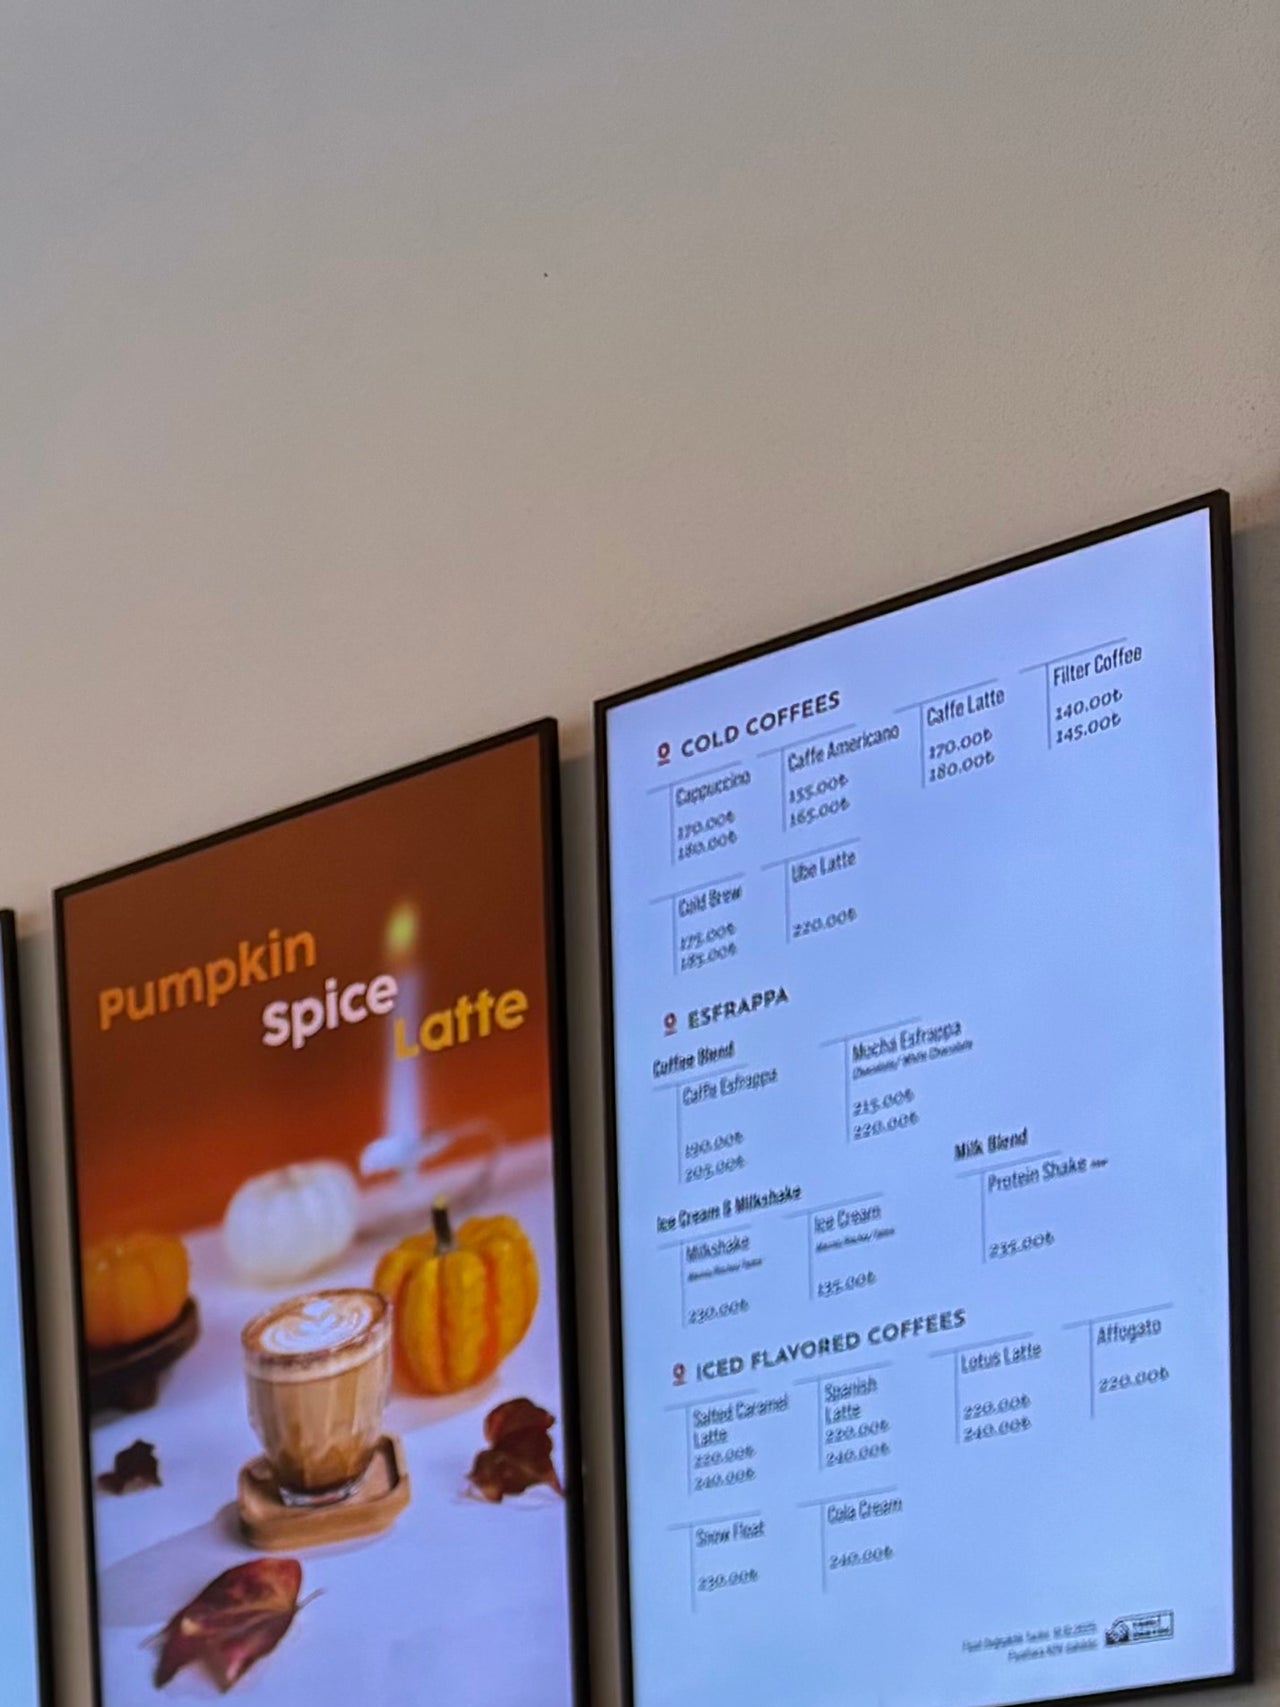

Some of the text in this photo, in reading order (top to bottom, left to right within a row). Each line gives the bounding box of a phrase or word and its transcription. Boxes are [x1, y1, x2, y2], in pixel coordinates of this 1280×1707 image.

[1053, 646, 1142, 687] Filter Coffee
[681, 690, 840, 757] COLD COFFEES
[927, 688, 1004, 726] Caffe Latte
[788, 725, 899, 772] Caffe Americano
[676, 770, 751, 807] Cappuccino
[791, 851, 856, 883] Ube Latte
[678, 885, 742, 918] Cold Brew
[99, 928, 317, 1031] Pumpkin
[393, 988, 529, 1060] Latte
[688, 987, 789, 1029] ESFRAPPA
[852, 1021, 962, 1062] Mocha Esfrappa
[653, 1041, 734, 1078] Coffee Blend
[955, 1127, 1028, 1161] Milk Blend
[989, 1156, 1087, 1192] Protein Shake
[656, 1215, 677, 1233] Ice
[679, 1205, 720, 1228] Cream
[735, 1185, 801, 1213] Milkshake
[814, 1204, 882, 1234] Ice Cream
[686, 1236, 750, 1263] Milkshake
[696, 1308, 966, 1382] ICED FLAVORED COFFEES
[1097, 1318, 1162, 1346] Affogato
[960, 1342, 1042, 1374] Lotus Latte
[825, 1376, 877, 1402] Spanish
[693, 1395, 790, 1428] Salted Caramel
[825, 1403, 861, 1425] Latte
[693, 1428, 728, 1449] Latte
[827, 1498, 903, 1525] Cola Cream
[733, 1520, 765, 1541] Float
